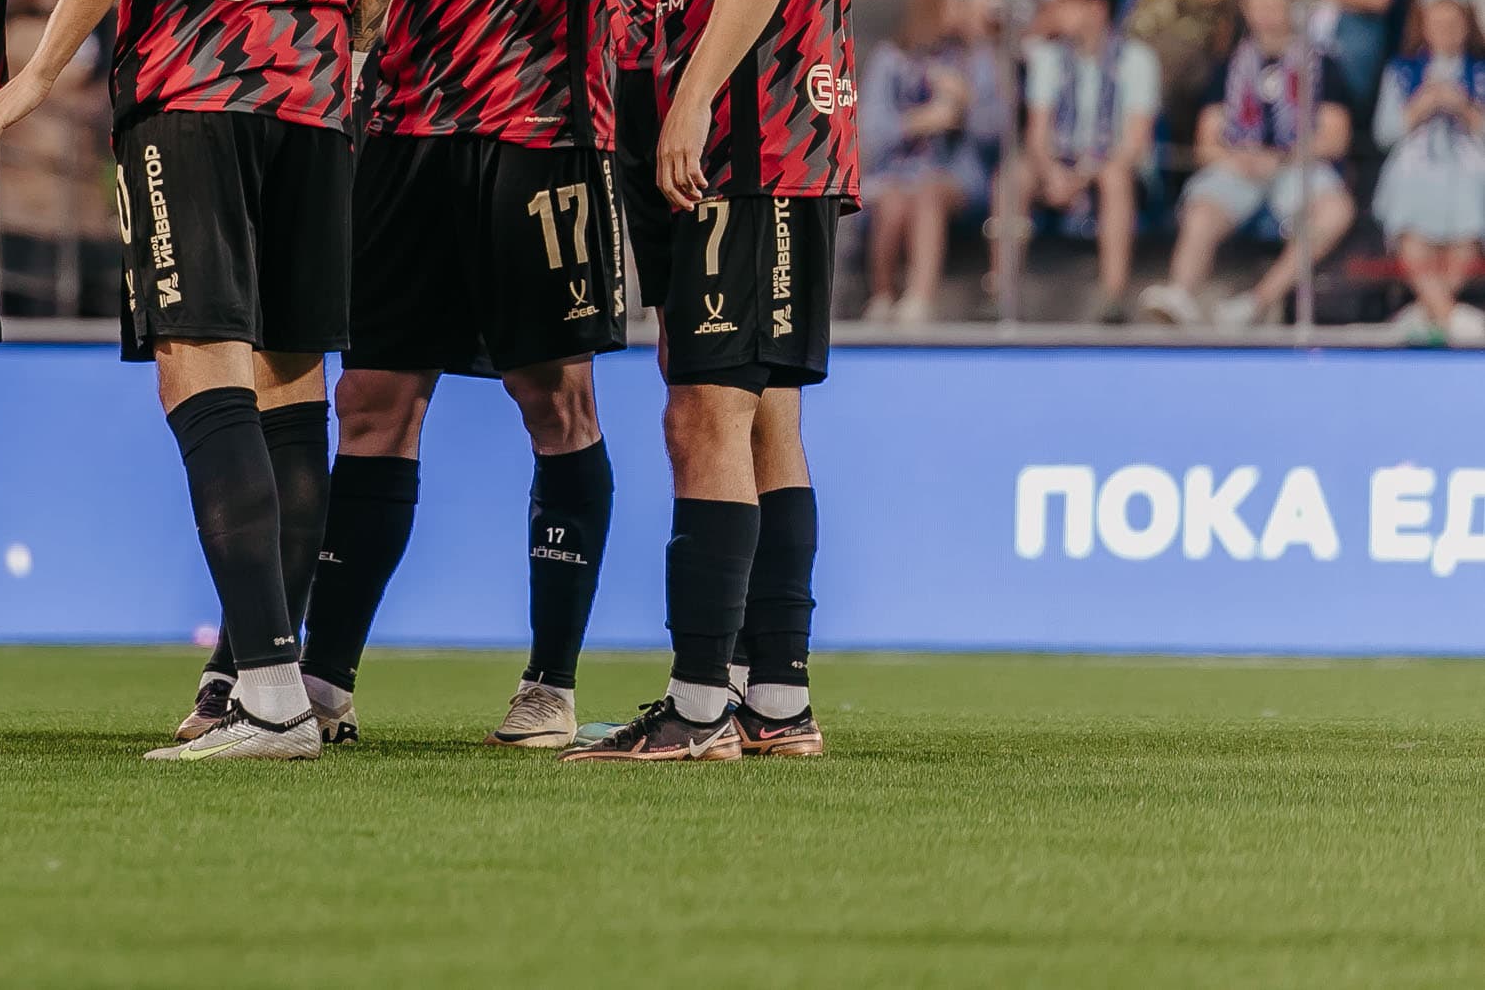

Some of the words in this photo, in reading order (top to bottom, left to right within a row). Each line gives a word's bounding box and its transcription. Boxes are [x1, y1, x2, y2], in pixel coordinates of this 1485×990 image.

[144, 144, 175, 268] ИНВЕРТОР
[527, 182, 589, 270] 17
[698, 200, 730, 276] 7
[563, 305, 600, 322] JÖGEL
[694, 321, 738, 335] JÖGEL
[546, 527, 565, 544] 17
[1016, 465, 1341, 561] ПОКА
[530, 545, 588, 565] JÖGEL
